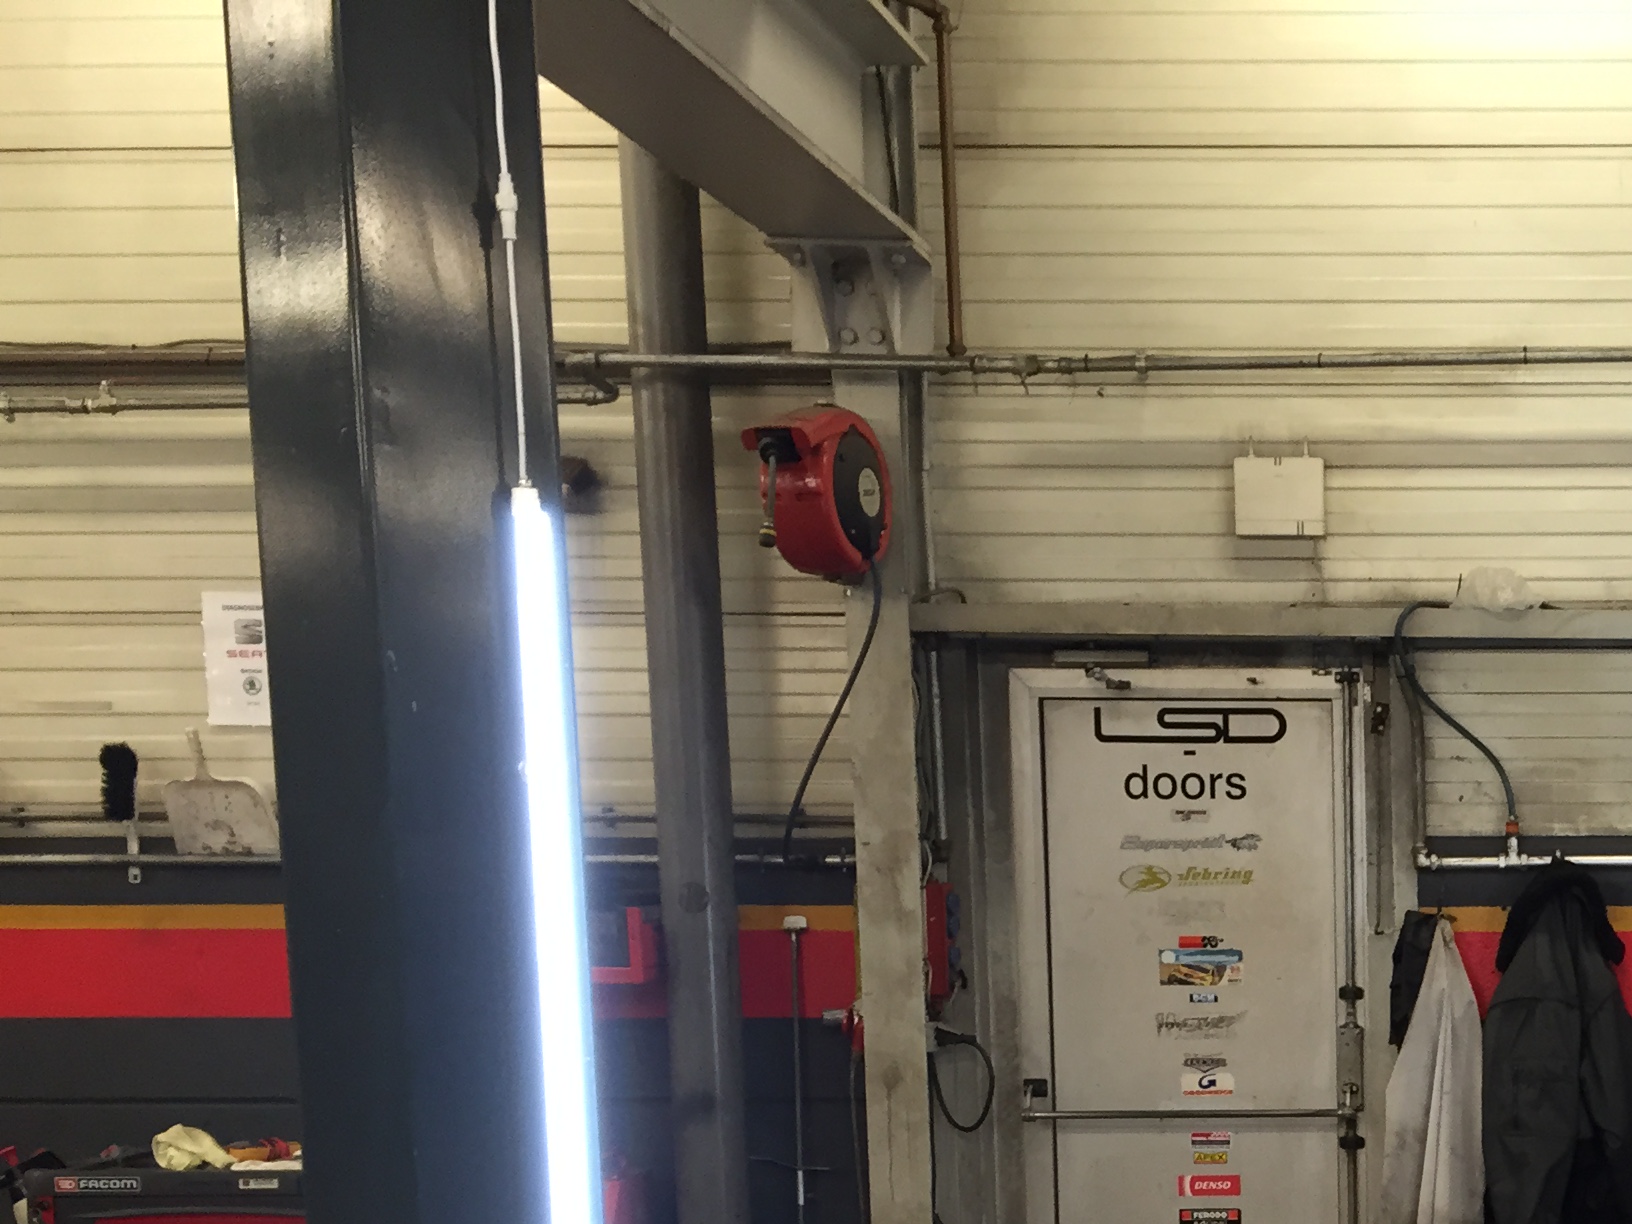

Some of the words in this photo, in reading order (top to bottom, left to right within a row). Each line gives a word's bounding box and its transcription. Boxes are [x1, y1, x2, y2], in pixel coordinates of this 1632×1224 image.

[226, 650, 266, 658] SEA
[1094, 707, 1287, 743] LSD
[1124, 764, 1248, 800] doors
[79, 1177, 138, 1189] FACOM
[1194, 1181, 1231, 1190] DENSO
